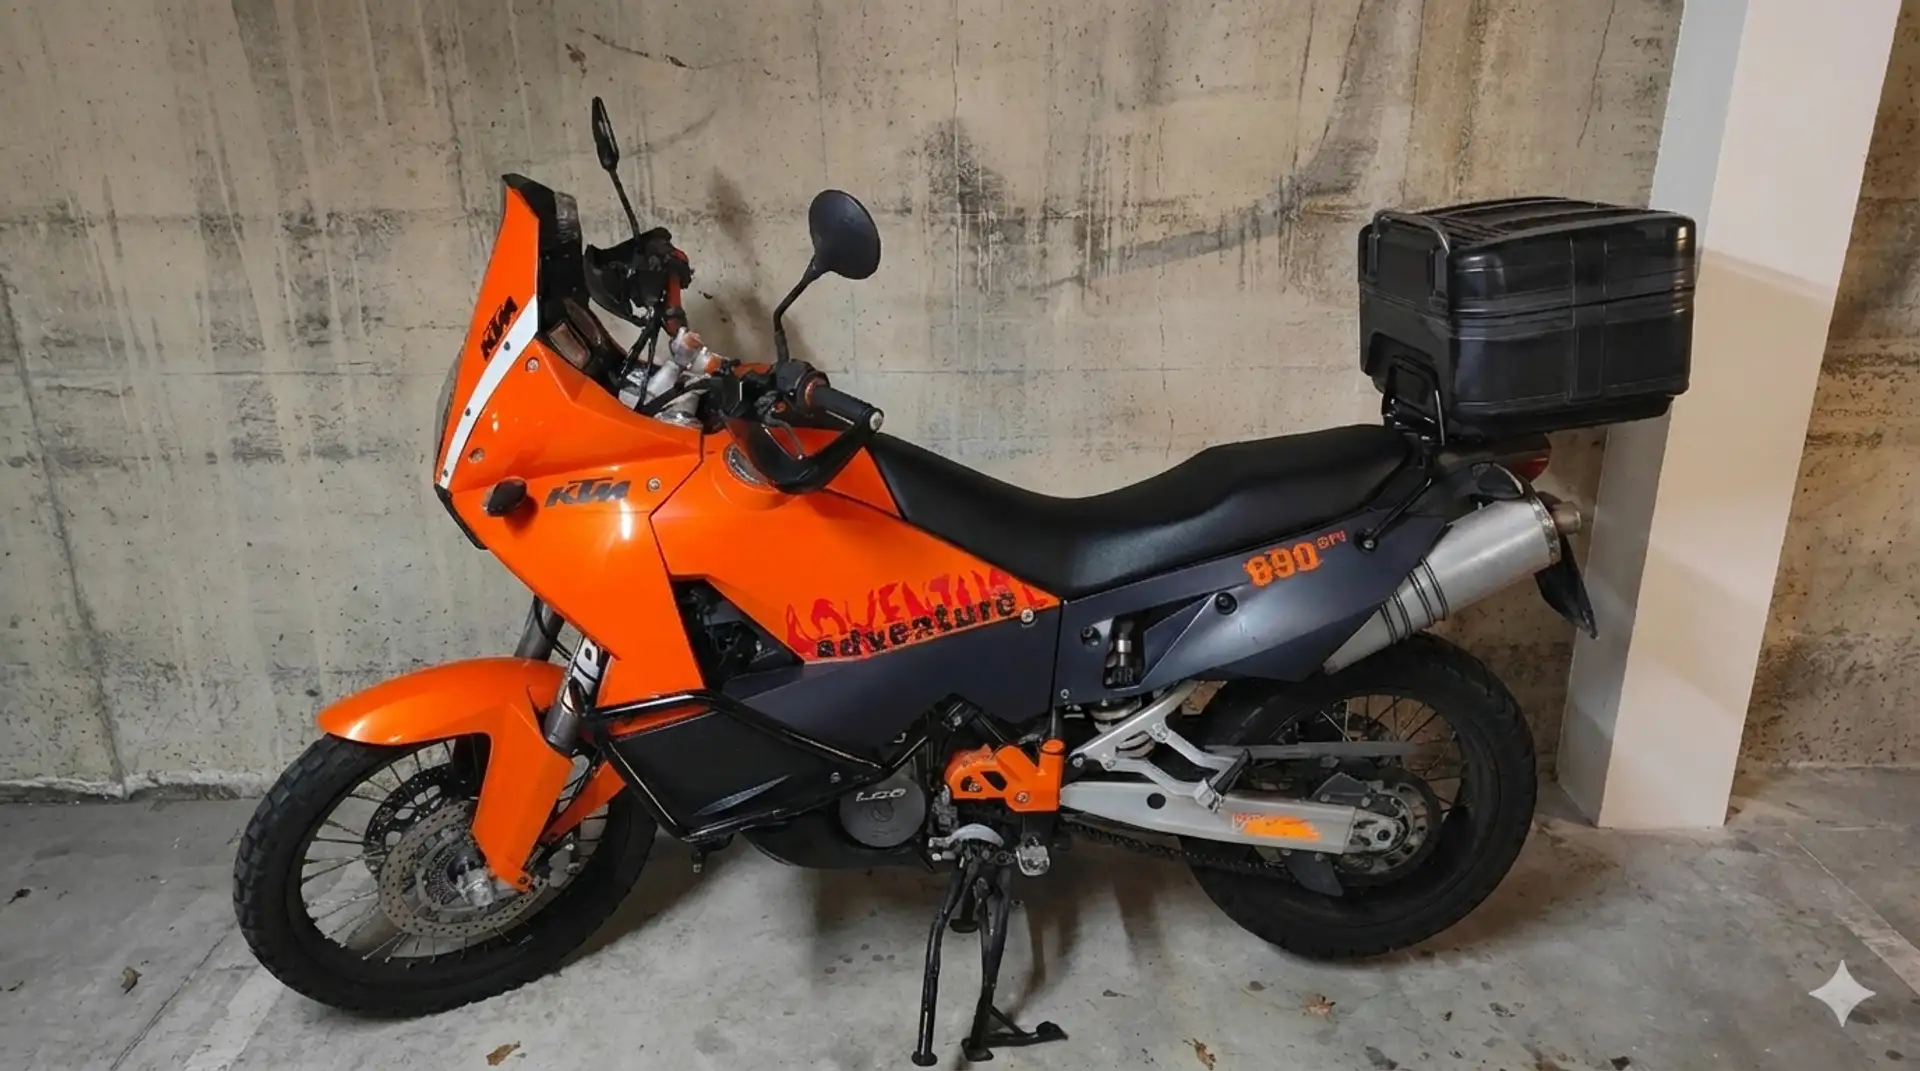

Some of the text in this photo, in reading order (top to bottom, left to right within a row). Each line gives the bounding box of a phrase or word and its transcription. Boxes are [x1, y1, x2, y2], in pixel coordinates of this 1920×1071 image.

[481, 296, 518, 361] KTM
[544, 477, 631, 507] KTM
[1243, 542, 1321, 586] 890
[816, 590, 1016, 657] adventure
